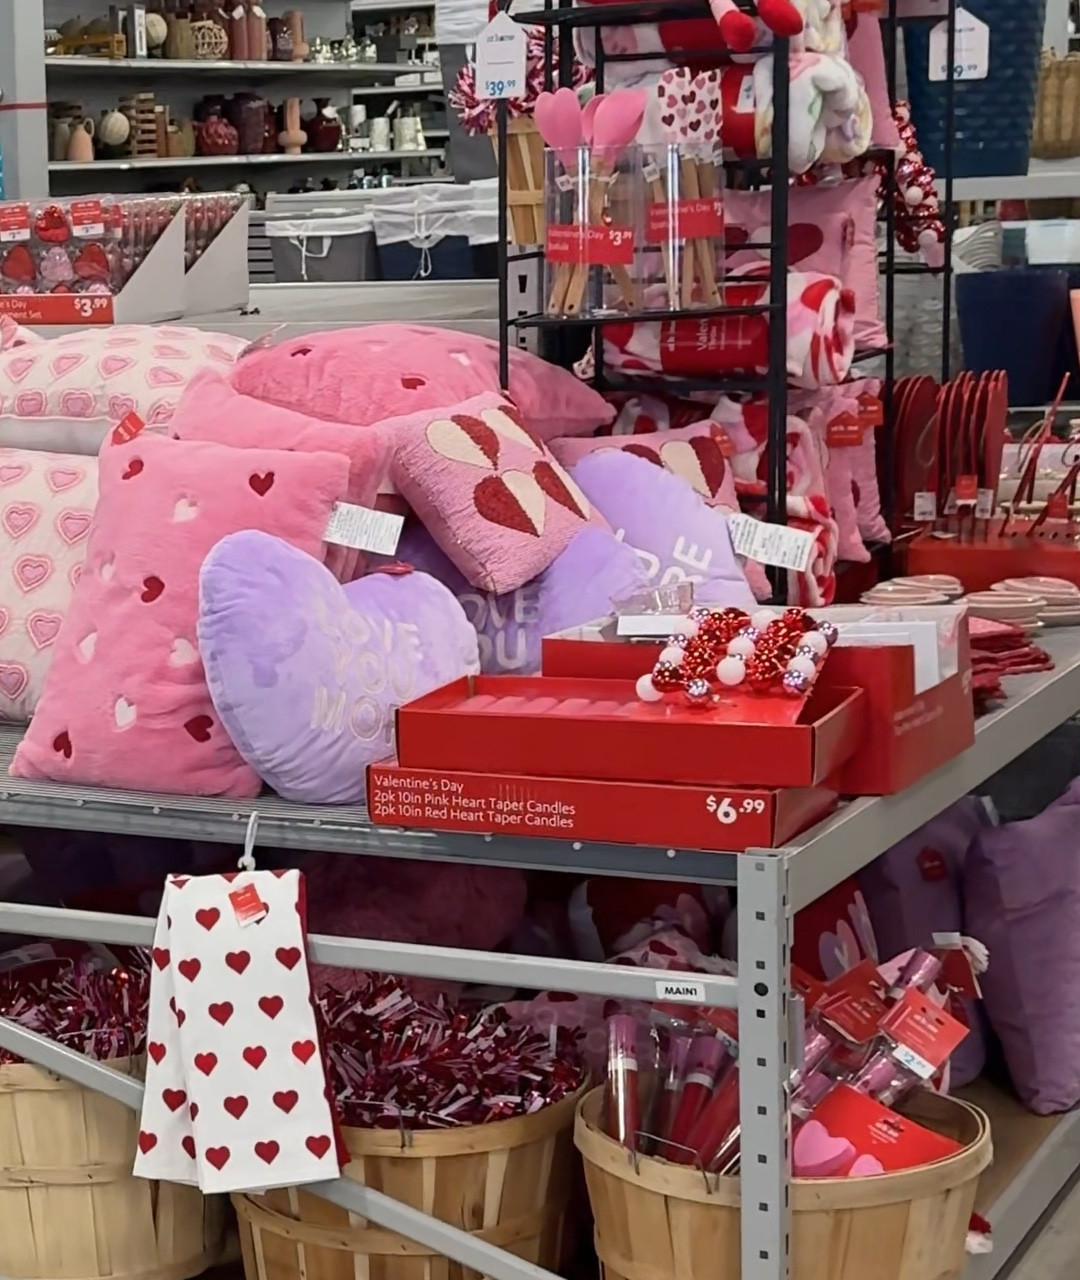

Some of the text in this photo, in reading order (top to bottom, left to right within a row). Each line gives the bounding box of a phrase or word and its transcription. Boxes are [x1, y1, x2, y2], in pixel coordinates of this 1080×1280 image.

[11, 298, 27, 311] Day
[74, 298, 108, 317] $3.99
[374, 775, 765, 824] Valentine's Day $6.99
[374, 789, 575, 815] 2pk 10in Pink Heart Taper Candles
[374, 803, 574, 829] 2pk 10in Red Heart Taper Candles
[664, 986, 697, 996] MAIN1
